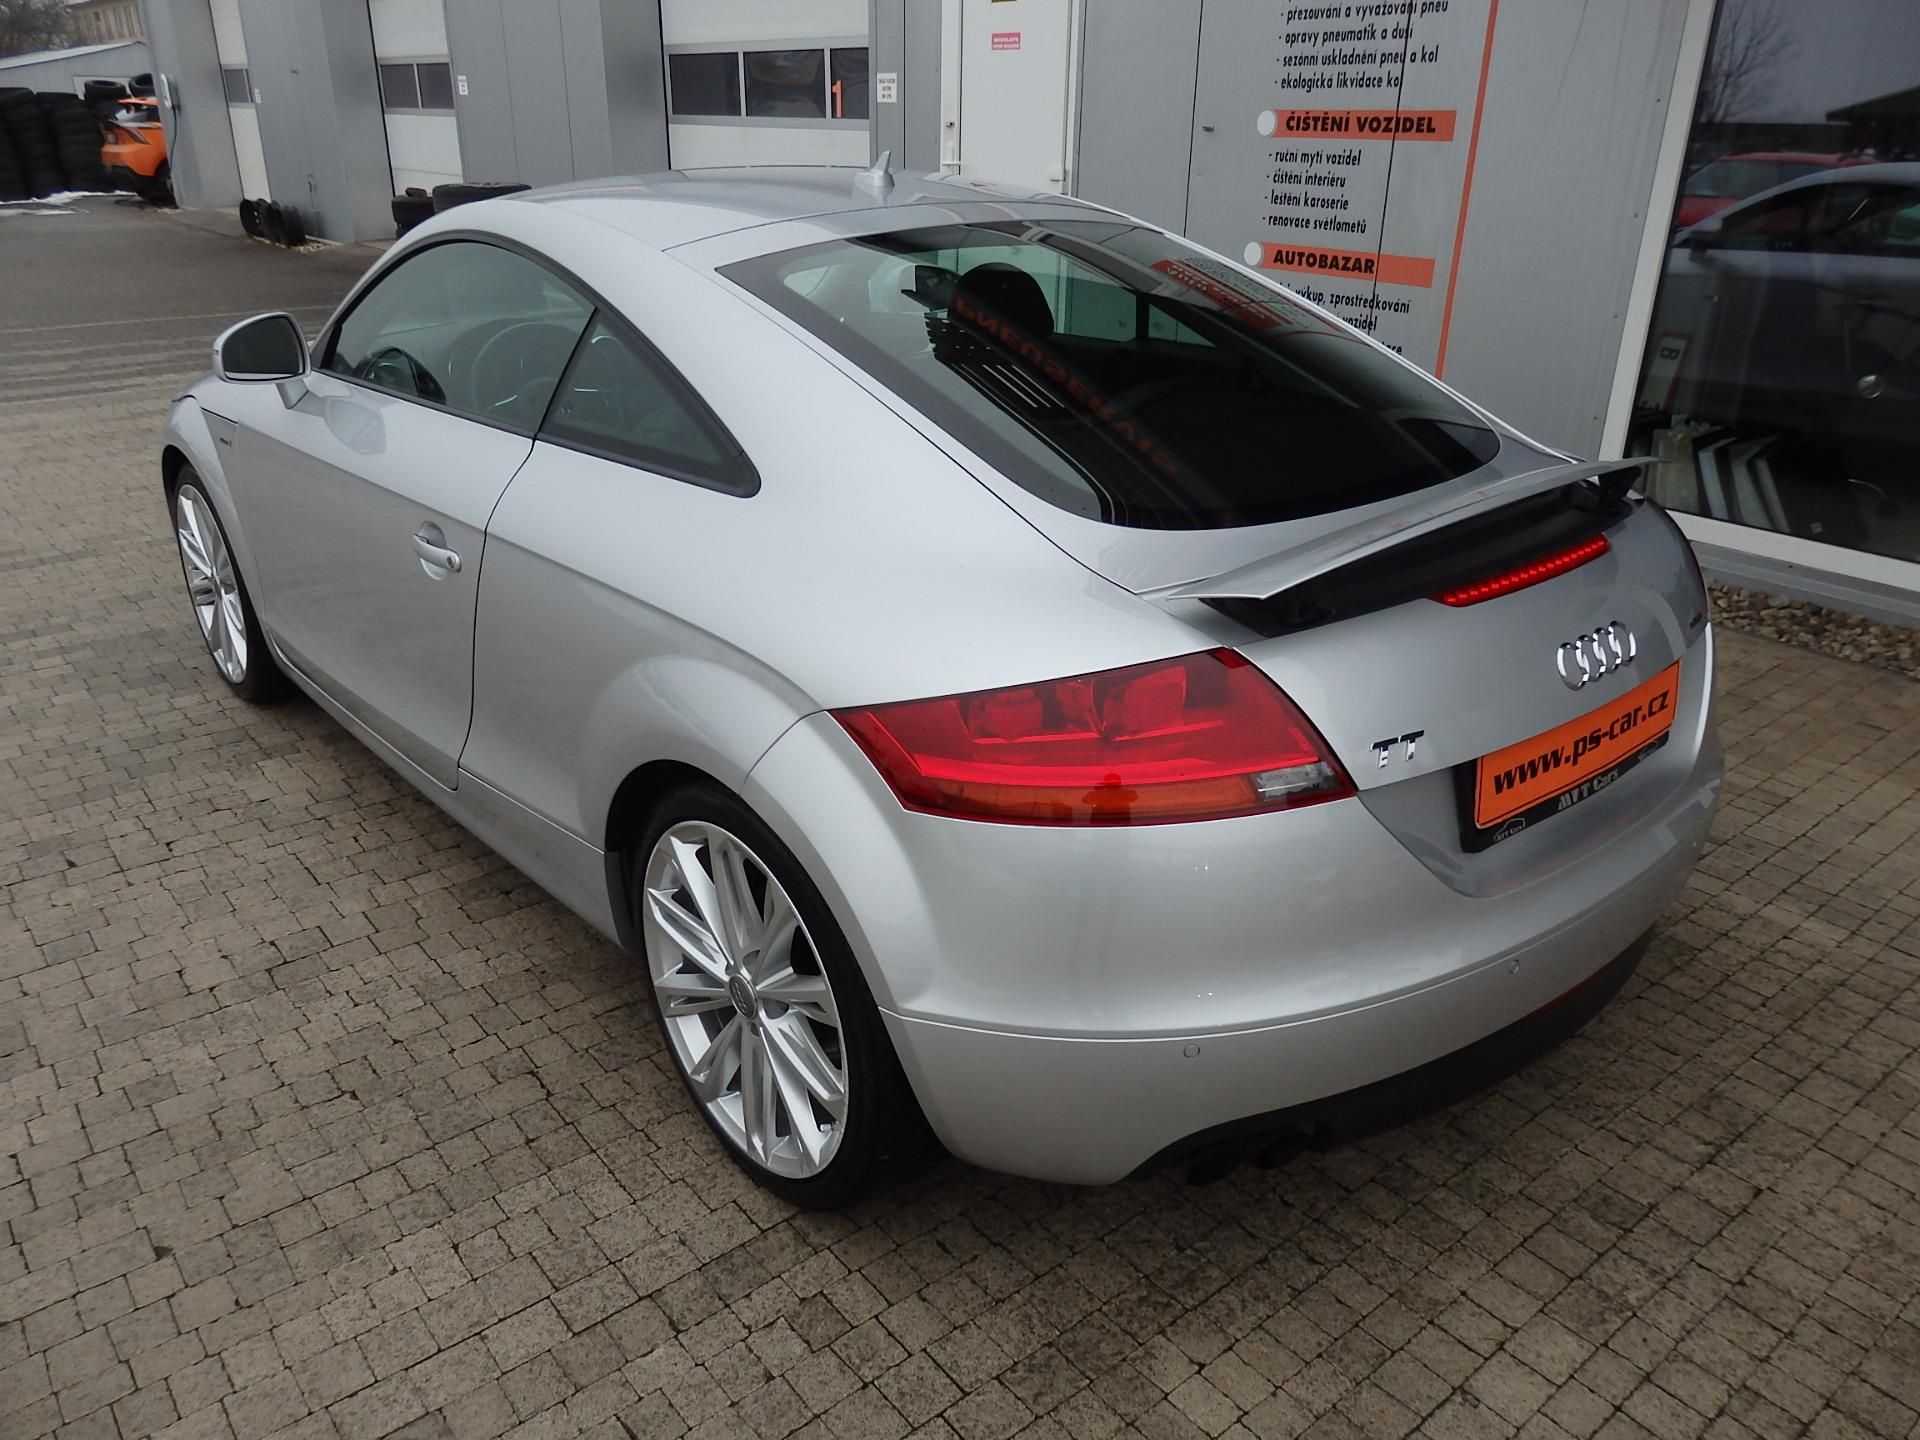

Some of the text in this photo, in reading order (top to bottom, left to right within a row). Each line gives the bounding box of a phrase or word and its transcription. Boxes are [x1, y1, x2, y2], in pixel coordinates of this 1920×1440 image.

[1344, 5, 1351, 17] a
[1420, 0, 1448, 18] pneu
[1285, 30, 1319, 48] opravy
[1322, 23, 1377, 46] pneumatik
[1381, 28, 1388, 40] a
[1379, 51, 1406, 68] pneu
[1410, 51, 1417, 63] a
[1421, 44, 1439, 63] kol
[1281, 70, 1403, 93] ekologická likvidace ko
[832, 80, 843, 118] 1
[1285, 111, 1436, 134] ČIŠTĚNÍ VOZIDEL
[1326, 149, 1362, 166] vozidel
[1304, 169, 1346, 188] interiéru
[1271, 189, 1349, 210] leštění karoserie
[1268, 214, 1367, 234] renovace světlometů
[1273, 249, 1376, 274] AUTOBAZAR
[1369, 729, 1425, 769] TT
[1493, 690, 1670, 795] www.ps-car.cz
